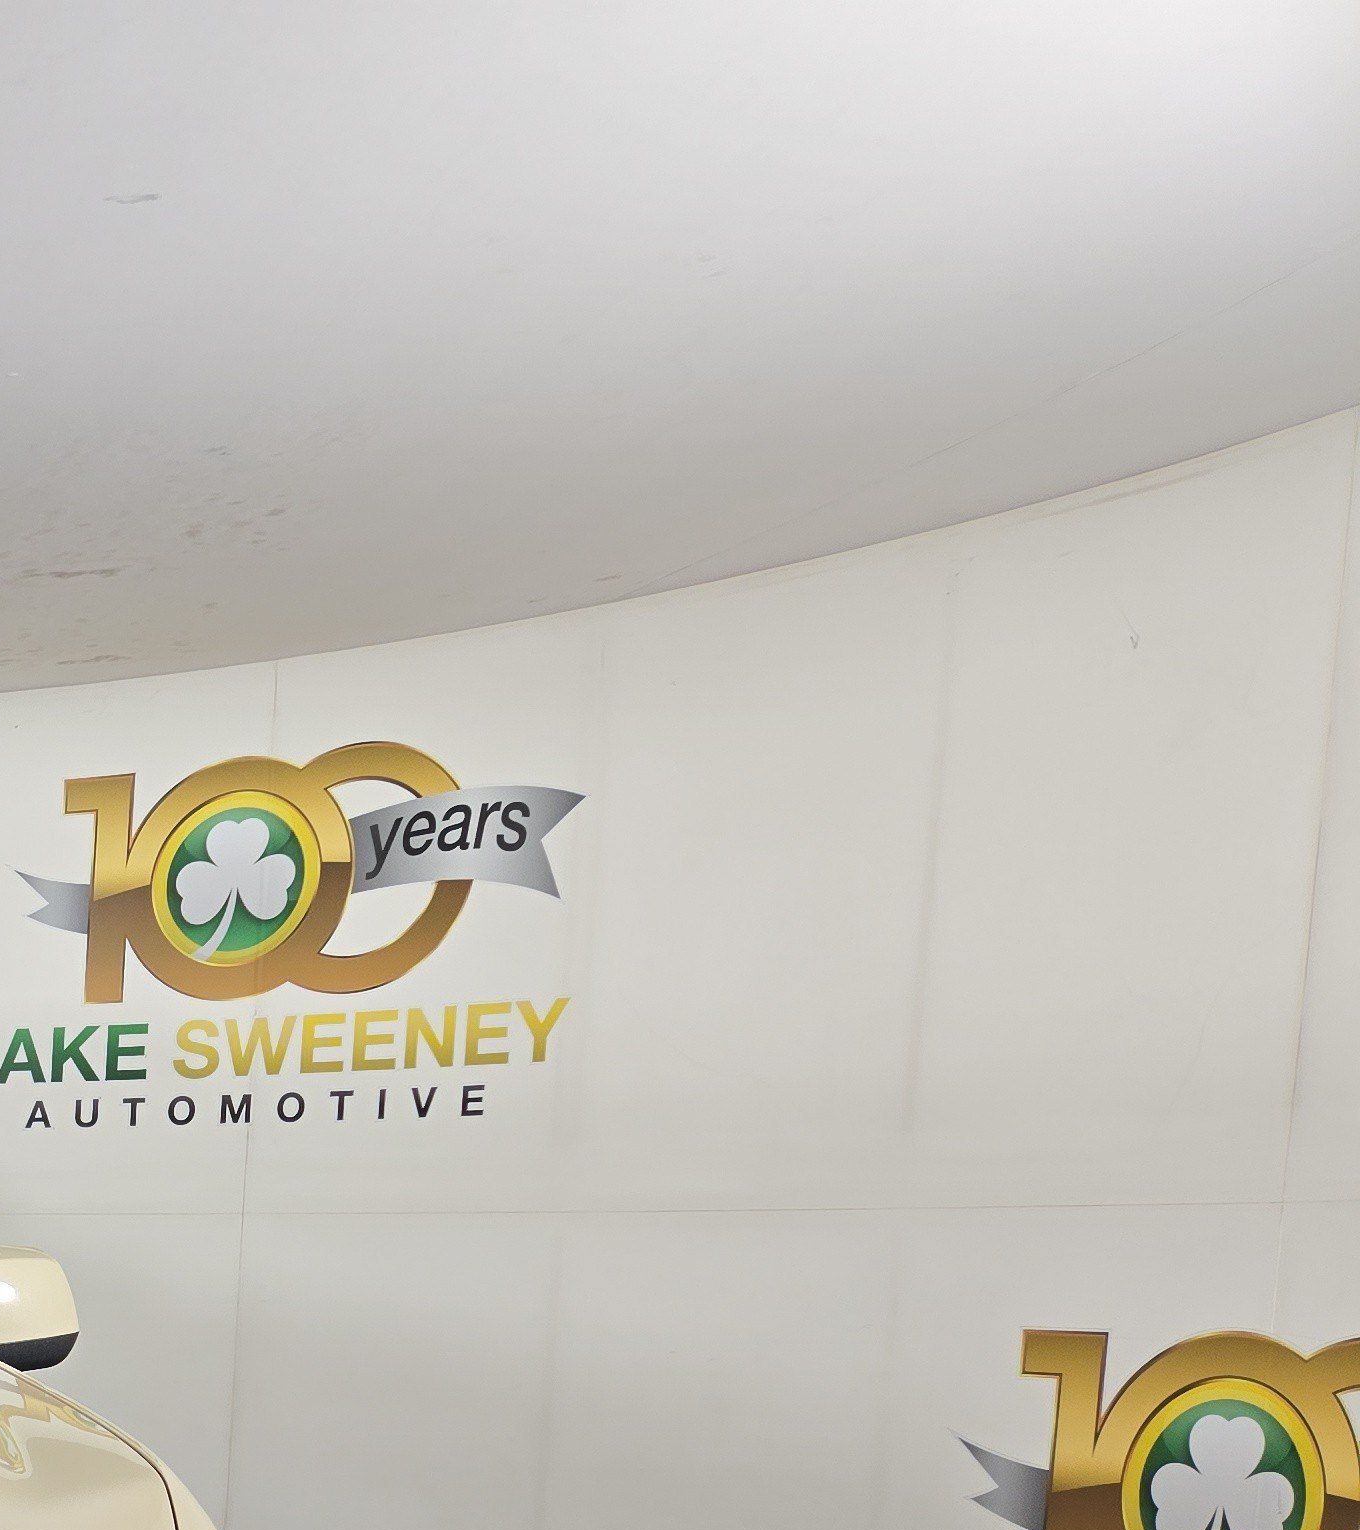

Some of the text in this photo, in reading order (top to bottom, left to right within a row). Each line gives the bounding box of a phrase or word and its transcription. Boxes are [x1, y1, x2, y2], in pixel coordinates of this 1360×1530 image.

[64, 741, 529, 1004] 100 years
[173, 997, 571, 1080] SWEENEY
[25, 1084, 486, 1130] AUTOMOTIVE
